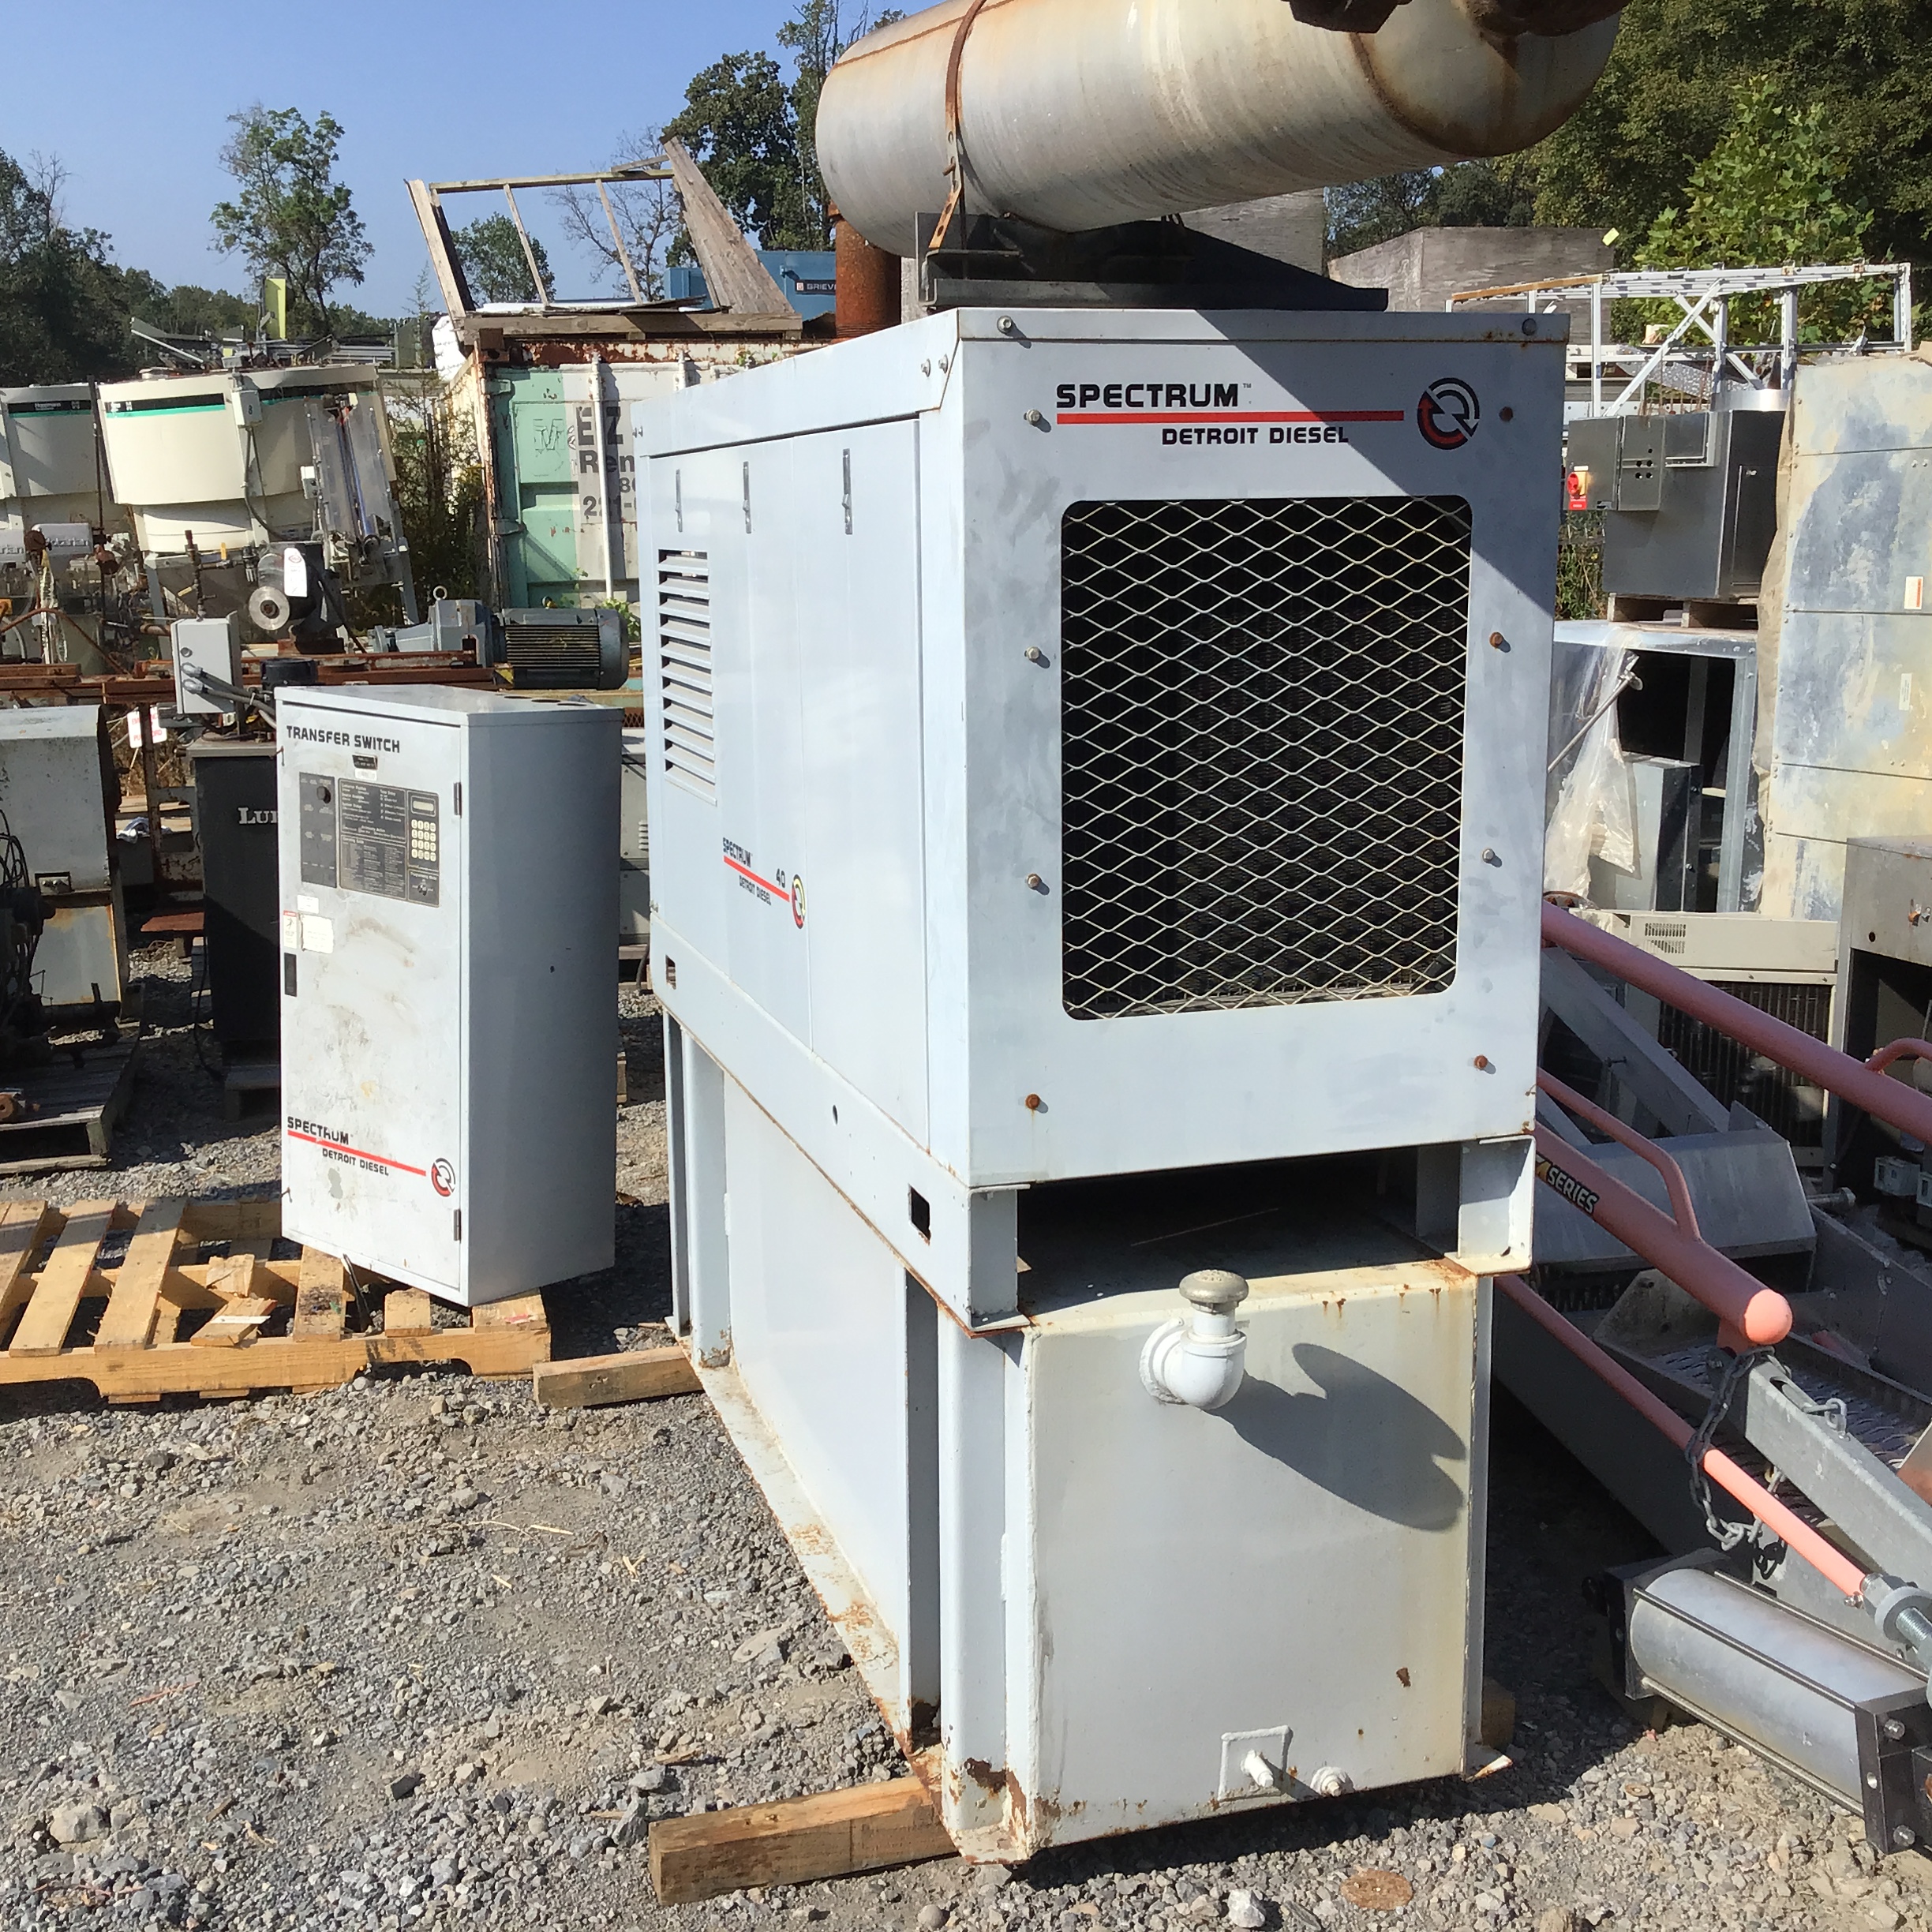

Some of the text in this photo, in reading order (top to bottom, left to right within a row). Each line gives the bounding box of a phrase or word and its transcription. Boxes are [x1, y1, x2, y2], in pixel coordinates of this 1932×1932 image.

[1056, 383, 1238, 409] SPECTRUM
[1162, 426, 1349, 445] DETROIT DIESEL
[286, 725, 400, 754] TRANSFER SWITCH
[722, 837, 786, 889] SPECTRUM 40
[739, 875, 771, 905] DETROIT DIESEL
[287, 1116, 349, 1145] SPECTRUM
[322, 1148, 389, 1177] DETROIT DIESEL
[1547, 1166, 1597, 1214] SERIES
